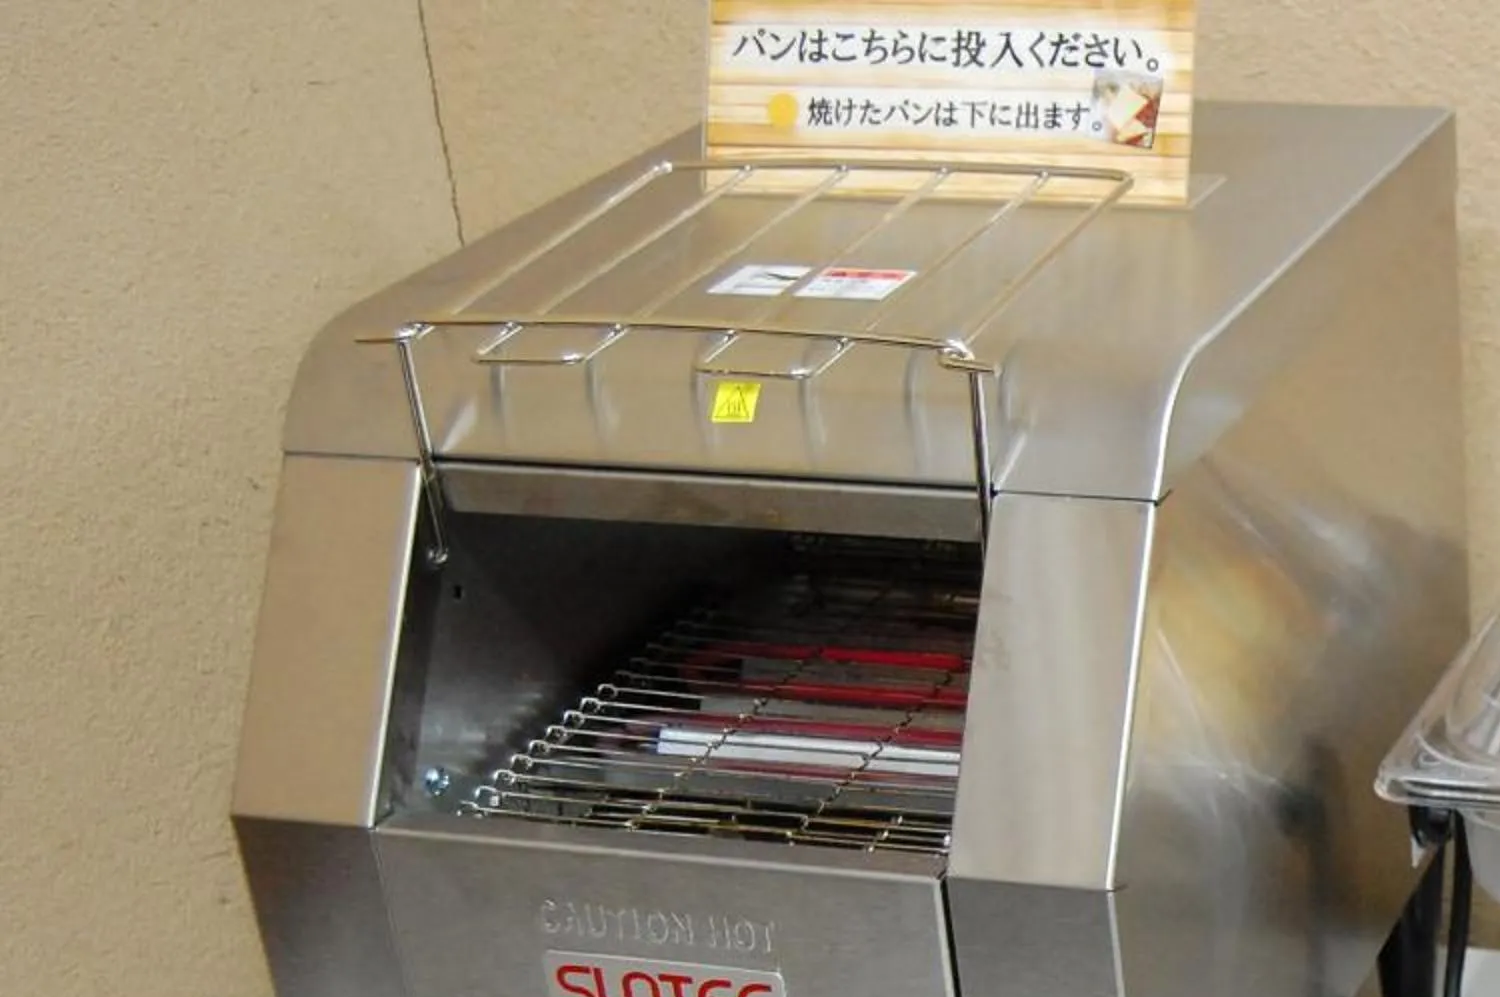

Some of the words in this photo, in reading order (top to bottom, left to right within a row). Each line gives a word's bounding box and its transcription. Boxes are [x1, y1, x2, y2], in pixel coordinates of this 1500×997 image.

[732, 28, 1159, 73] パンはこちらに投入ください。
[807, 97, 1104, 132] 焼けたパンは下に出ます。
[540, 899, 694, 946] CAUTION
[709, 914, 776, 953] HOT
